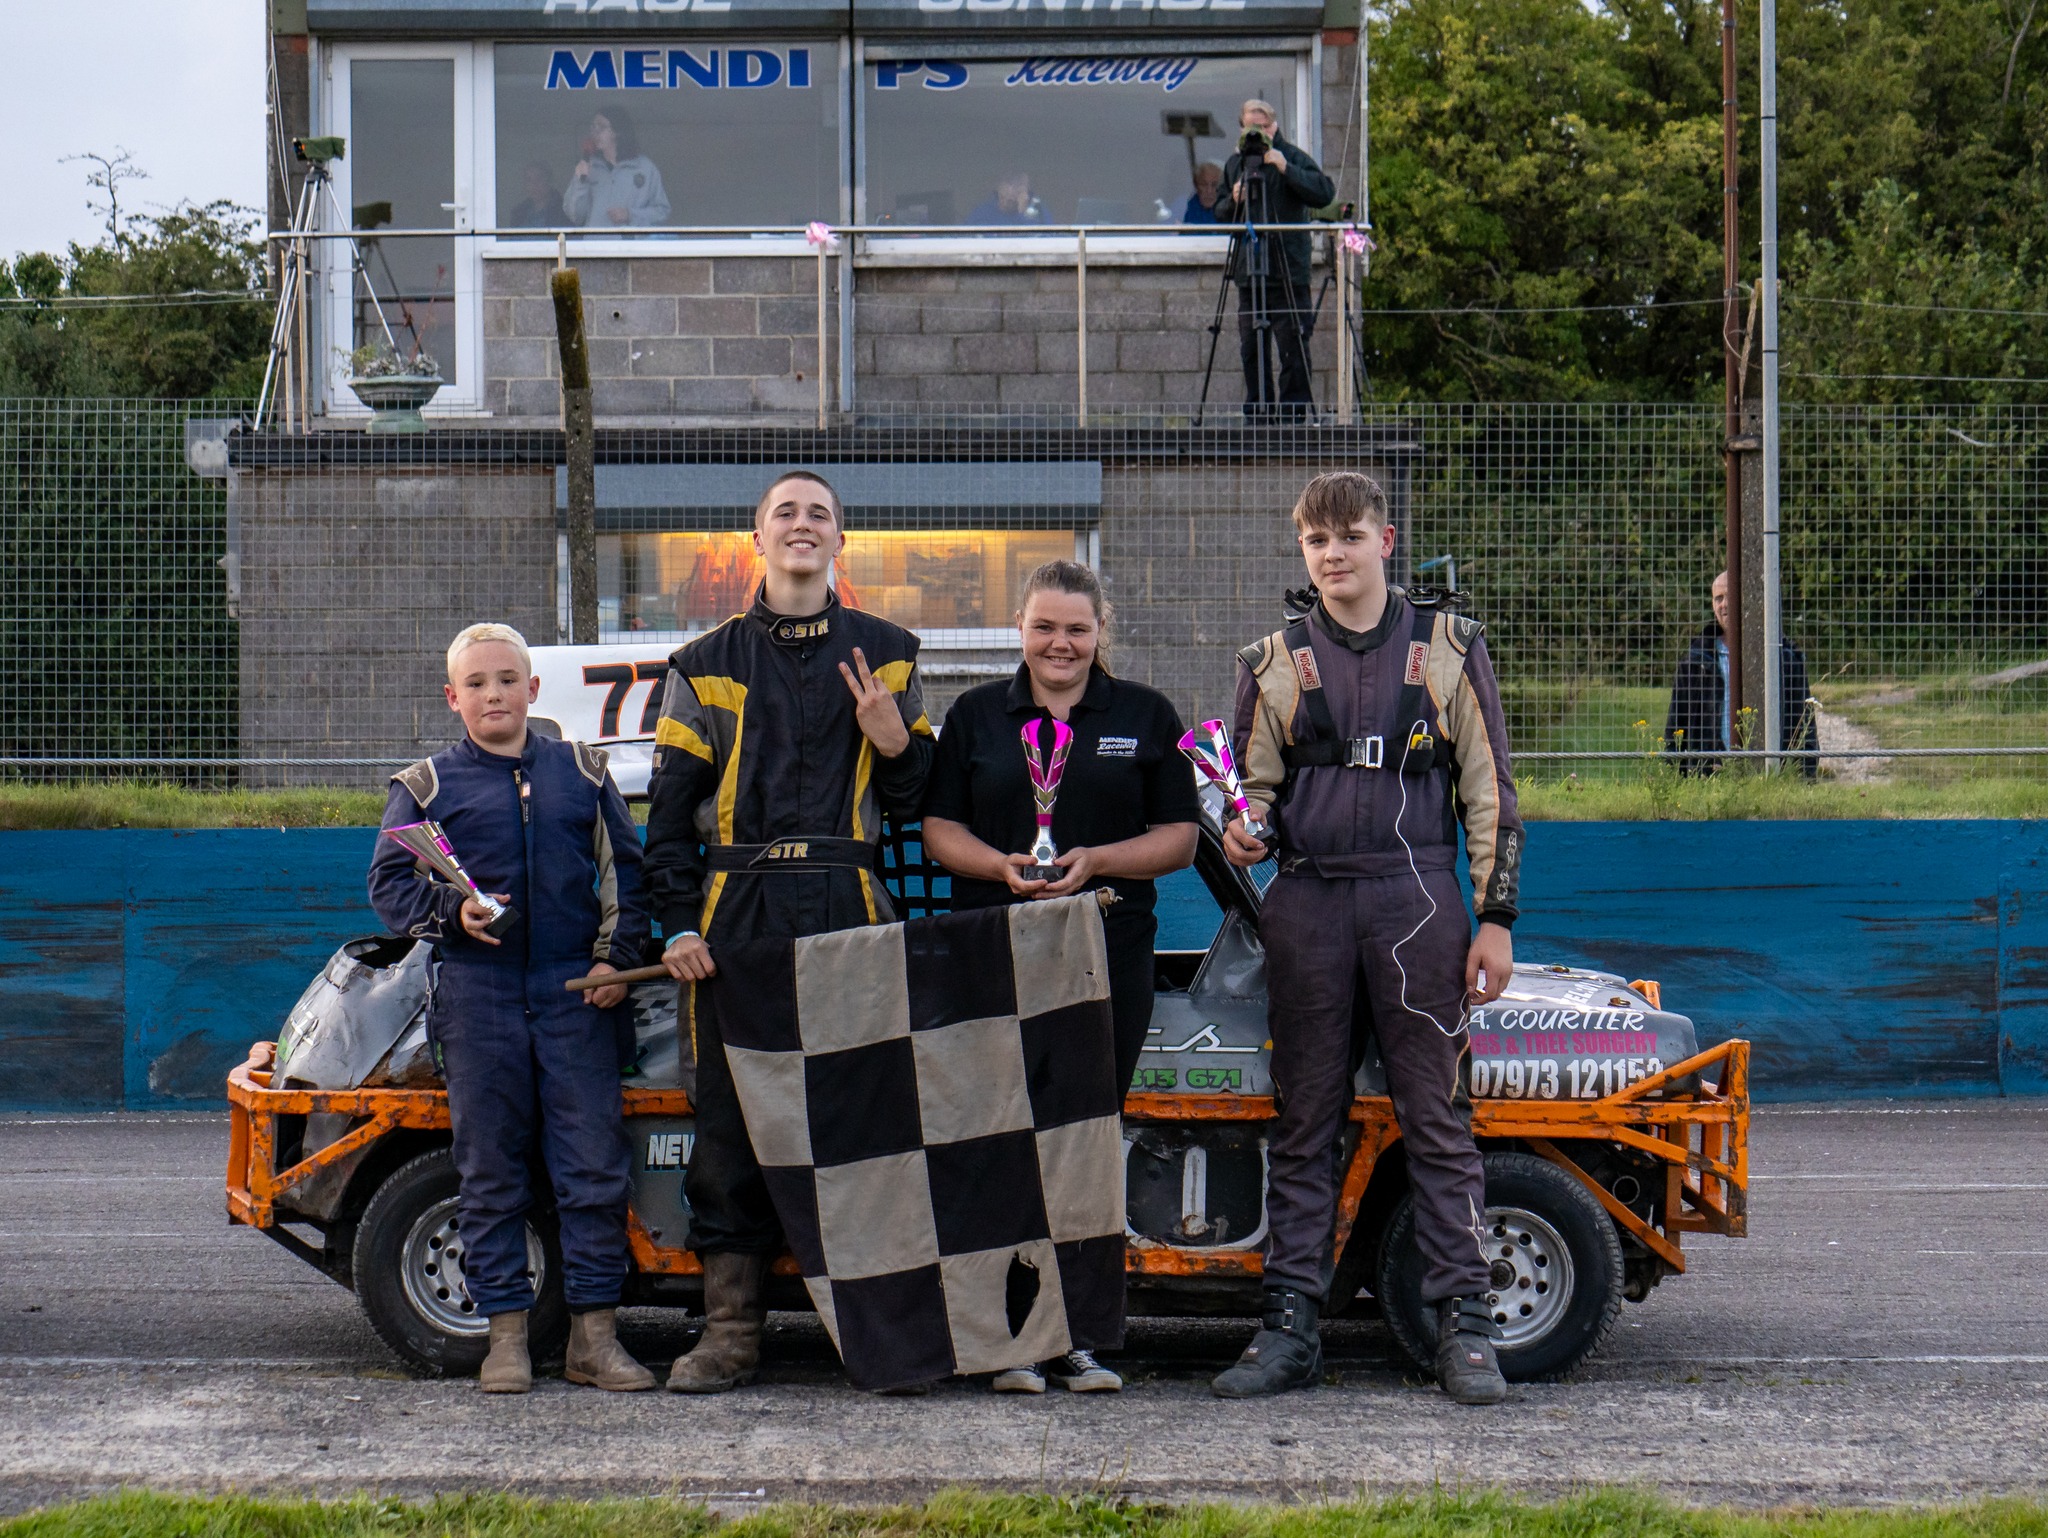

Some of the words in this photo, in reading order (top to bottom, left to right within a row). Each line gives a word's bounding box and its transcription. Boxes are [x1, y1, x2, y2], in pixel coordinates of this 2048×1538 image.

[544, 48, 811, 90] MENDI
[794, 618, 829, 639] STR
[1299, 651, 1316, 685] SIMPSON
[1410, 645, 1424, 681] SIMPSON
[582, 660, 669, 738] 77
[768, 842, 809, 859] STR
[1500, 1008, 1645, 1032] COURTIER
[1470, 1033, 1501, 1056] GS
[1506, 1035, 1520, 1055] &
[1522, 1032, 1569, 1055] TREE
[1571, 1032, 1657, 1055] SURGERY
[1186, 1067, 1242, 1089] 671
[1470, 1058, 1559, 1099] 07973
